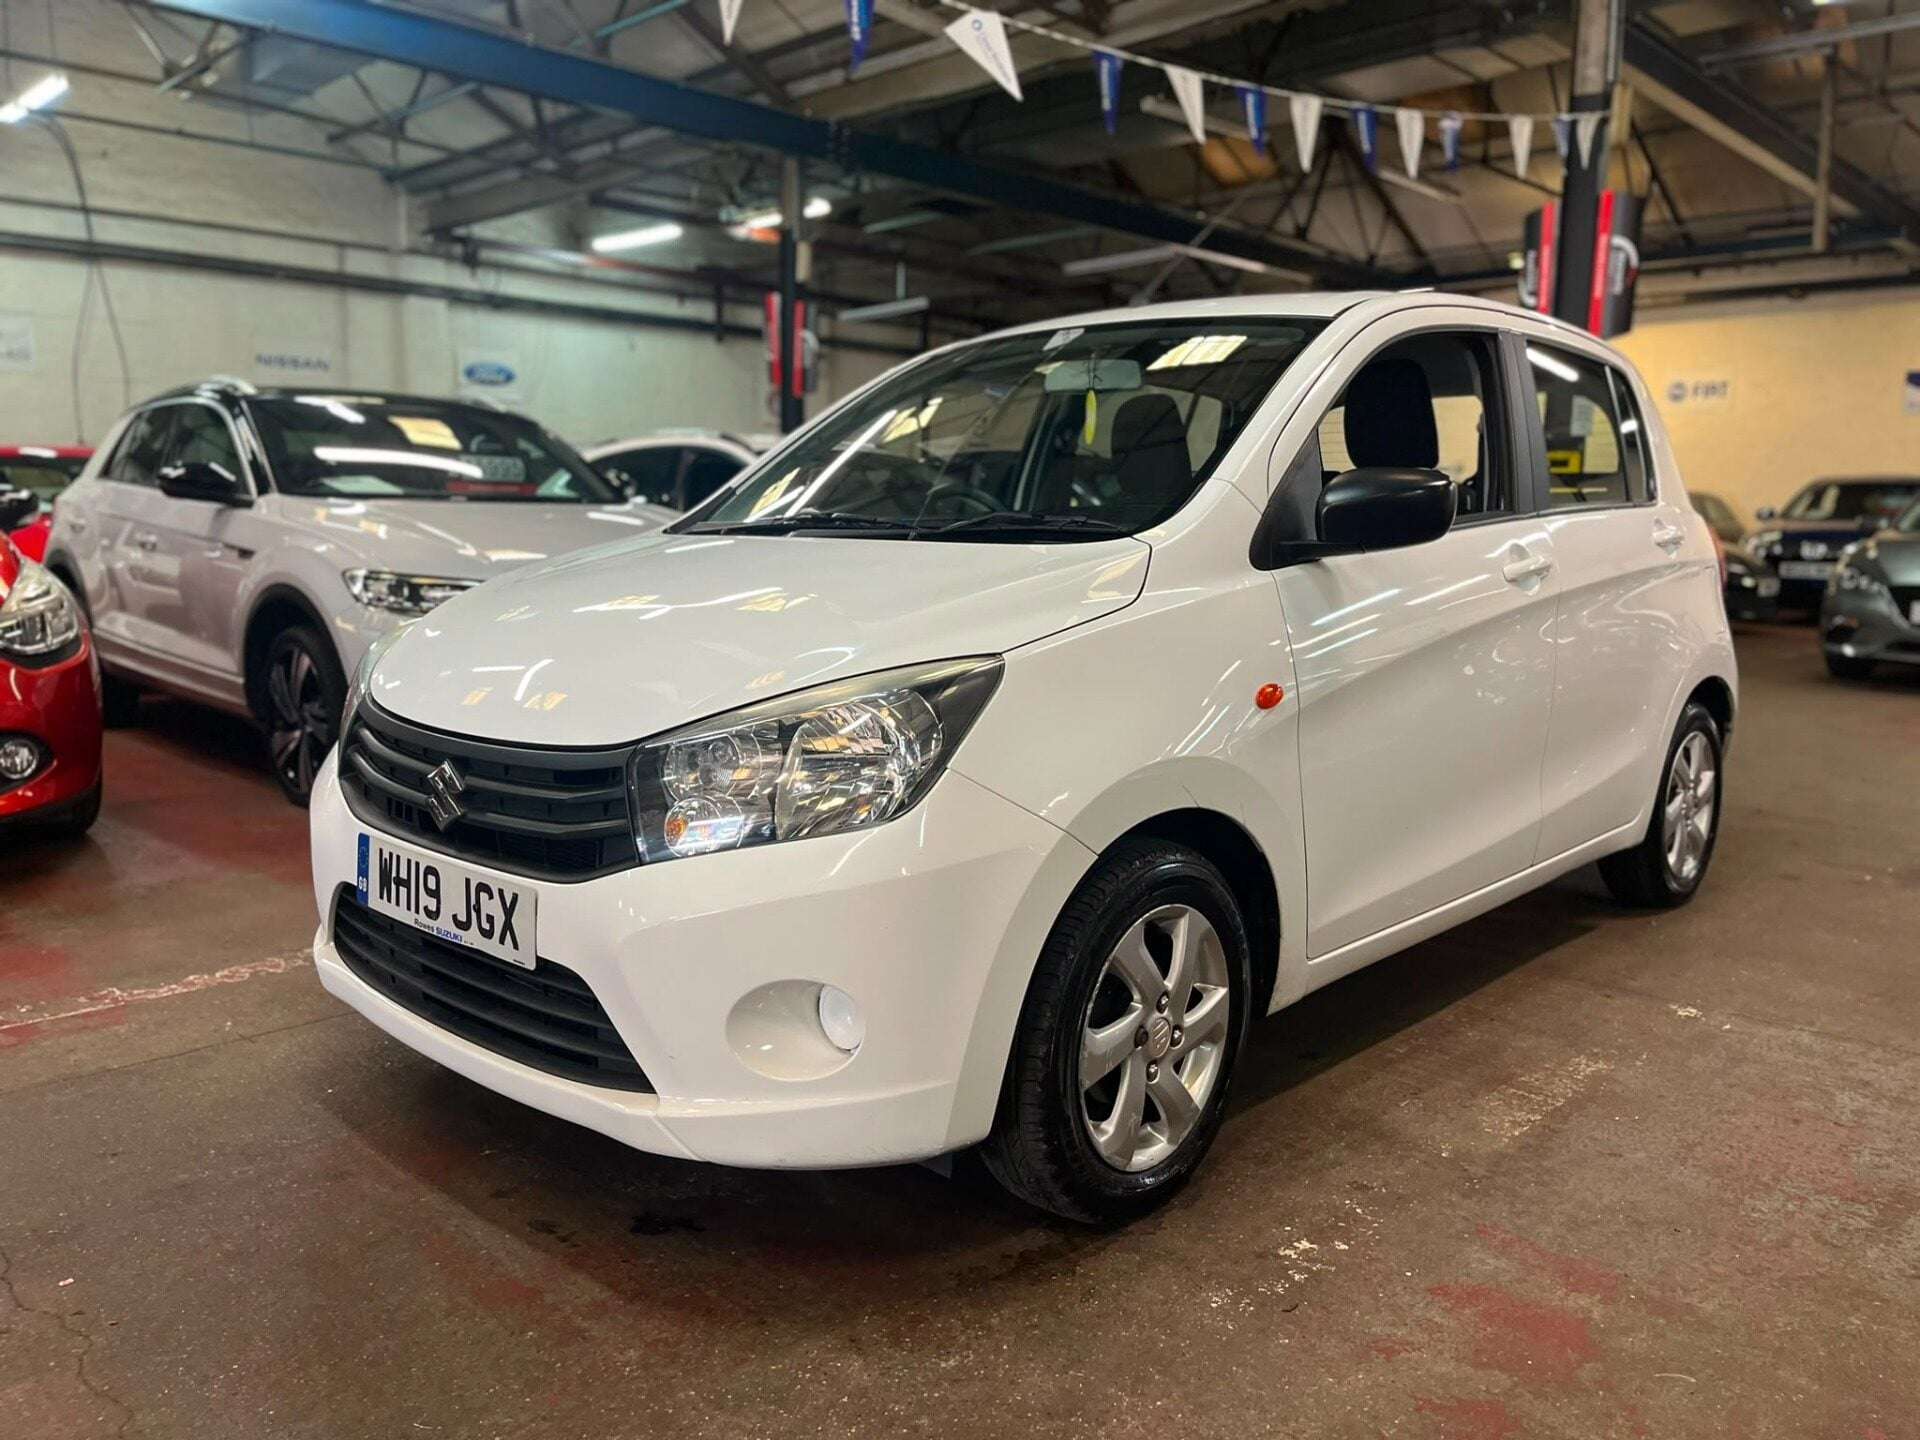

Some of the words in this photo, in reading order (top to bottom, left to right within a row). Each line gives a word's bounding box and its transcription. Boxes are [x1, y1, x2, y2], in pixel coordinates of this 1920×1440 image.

[379, 847, 441, 921] WH19
[452, 877, 519, 951] JGX
[435, 926, 464, 943] SUZUKI
